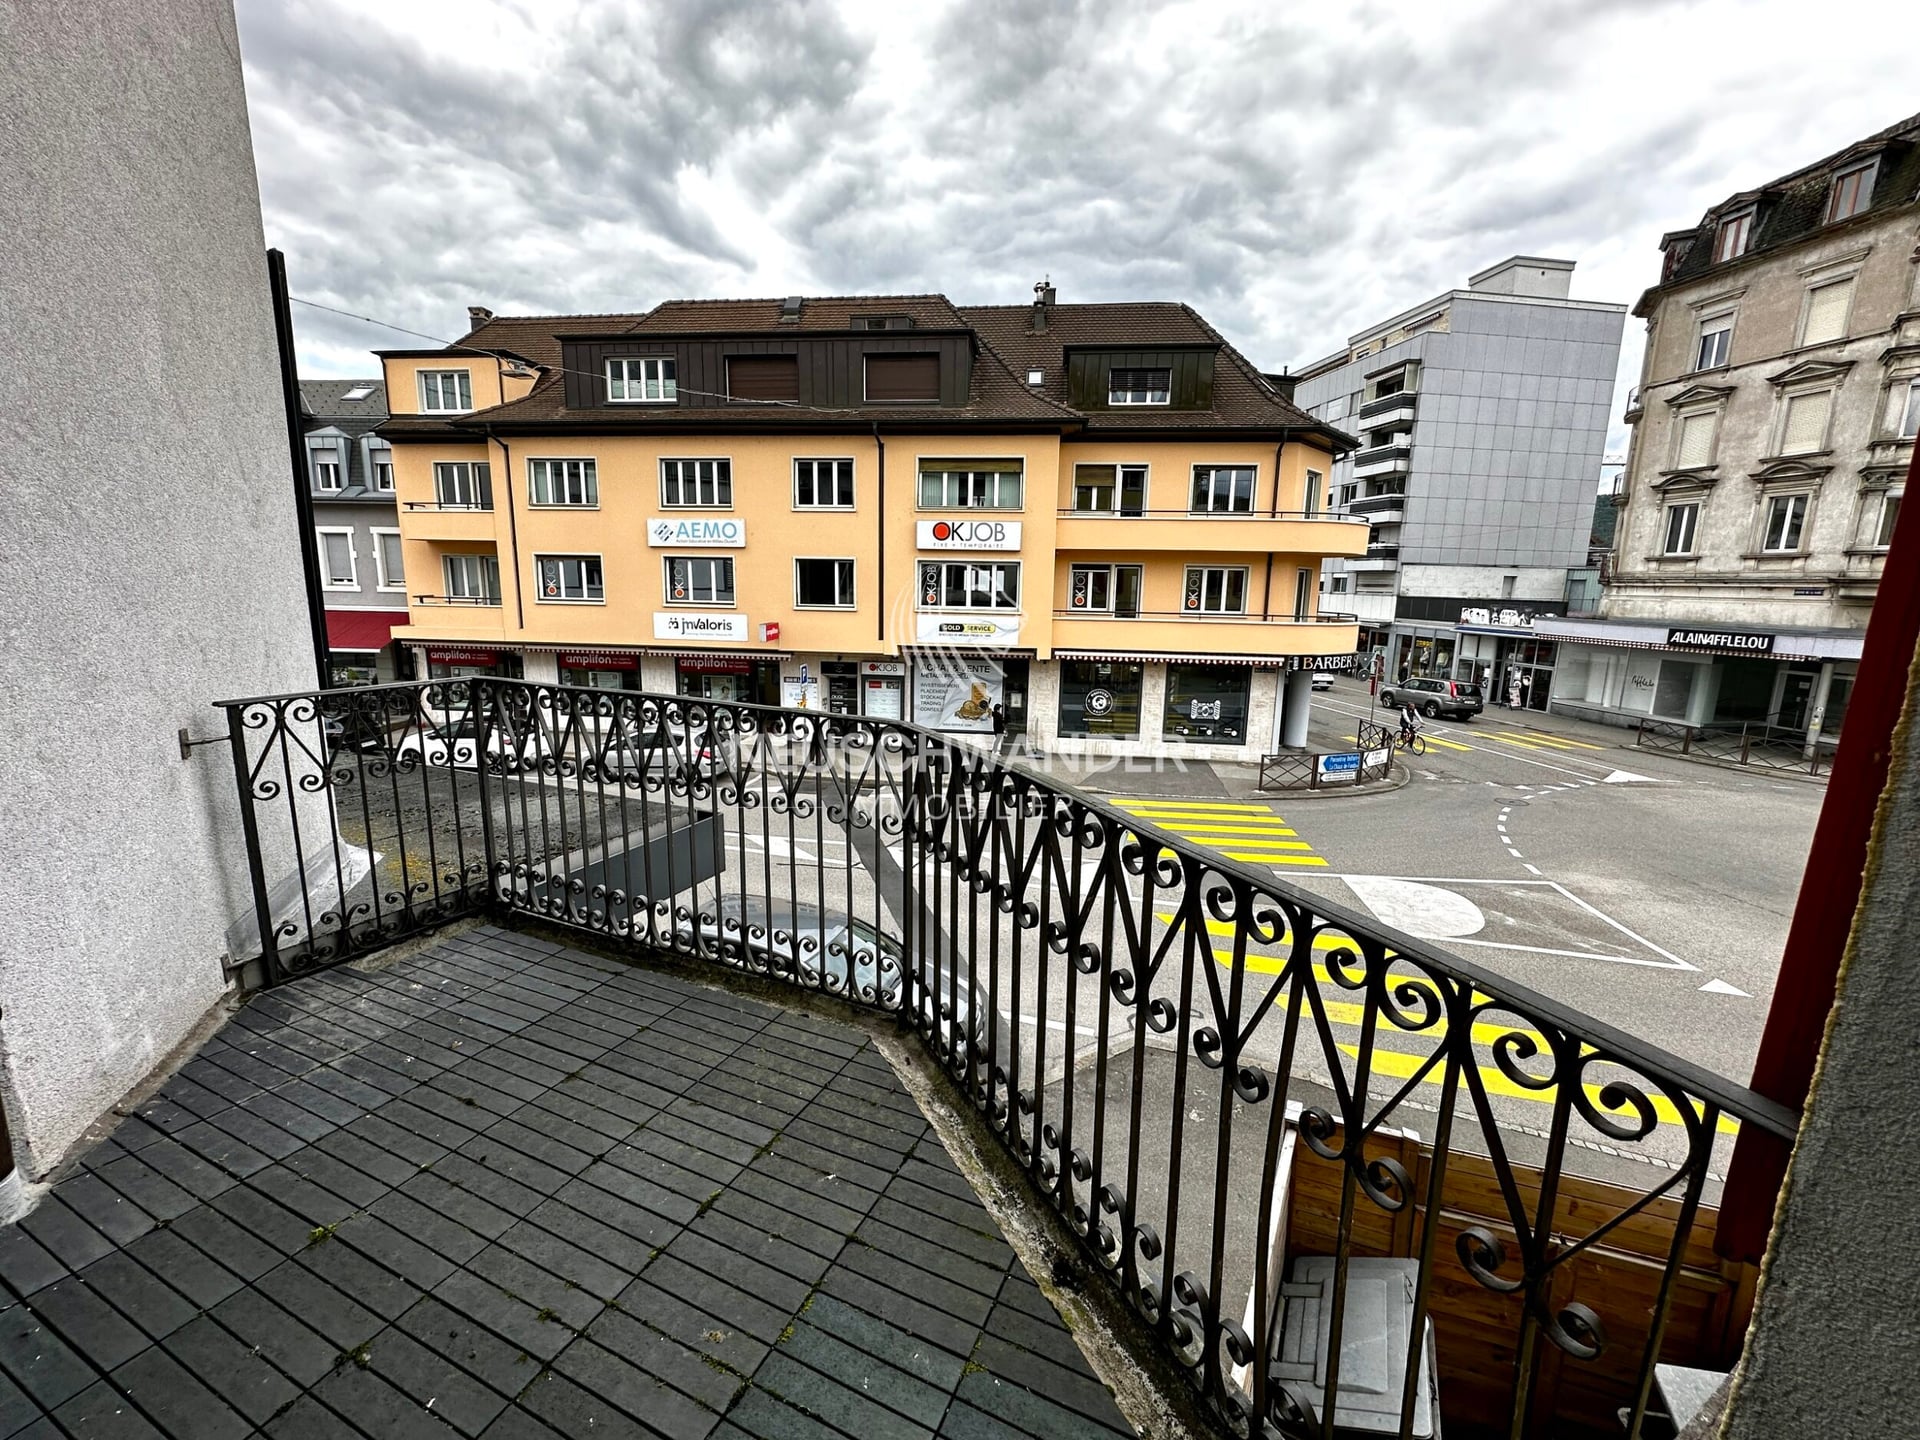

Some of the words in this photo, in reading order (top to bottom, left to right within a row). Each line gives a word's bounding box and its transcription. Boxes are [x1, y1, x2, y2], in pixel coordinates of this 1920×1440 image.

[676, 522, 737, 538] AEMO
[932, 521, 1006, 542] OKJOB
[430, 650, 471, 661] amplifon
[565, 654, 612, 666] amplifon
[680, 658, 728, 670] amplifon
